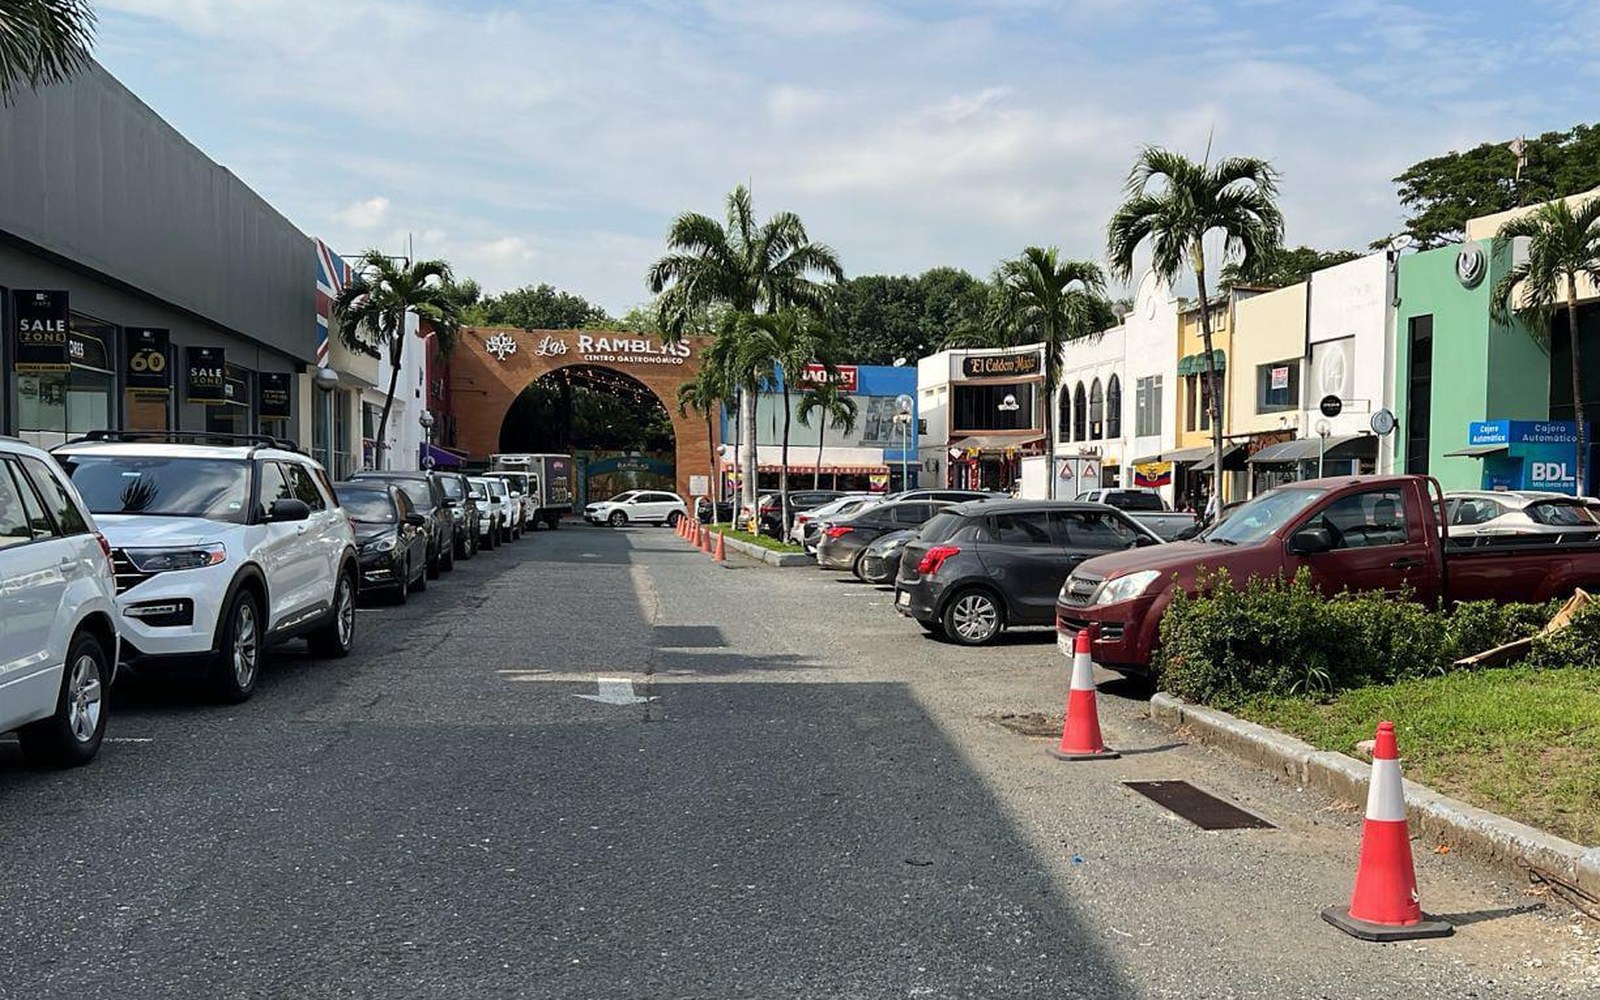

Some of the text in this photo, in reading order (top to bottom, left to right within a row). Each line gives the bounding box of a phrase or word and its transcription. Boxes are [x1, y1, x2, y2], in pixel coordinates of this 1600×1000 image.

[20, 319, 65, 331] SALE
[535, 335, 691, 358] Las RAMBLAS
[130, 352, 166, 372] 60
[584, 354, 616, 363] CENTRO
[970, 358, 985, 374] El
[190, 367, 223, 378] SALE
[1534, 423, 1567, 434] Cajero
[1522, 433, 1578, 443] Automático
[1532, 462, 1575, 481] BDL
